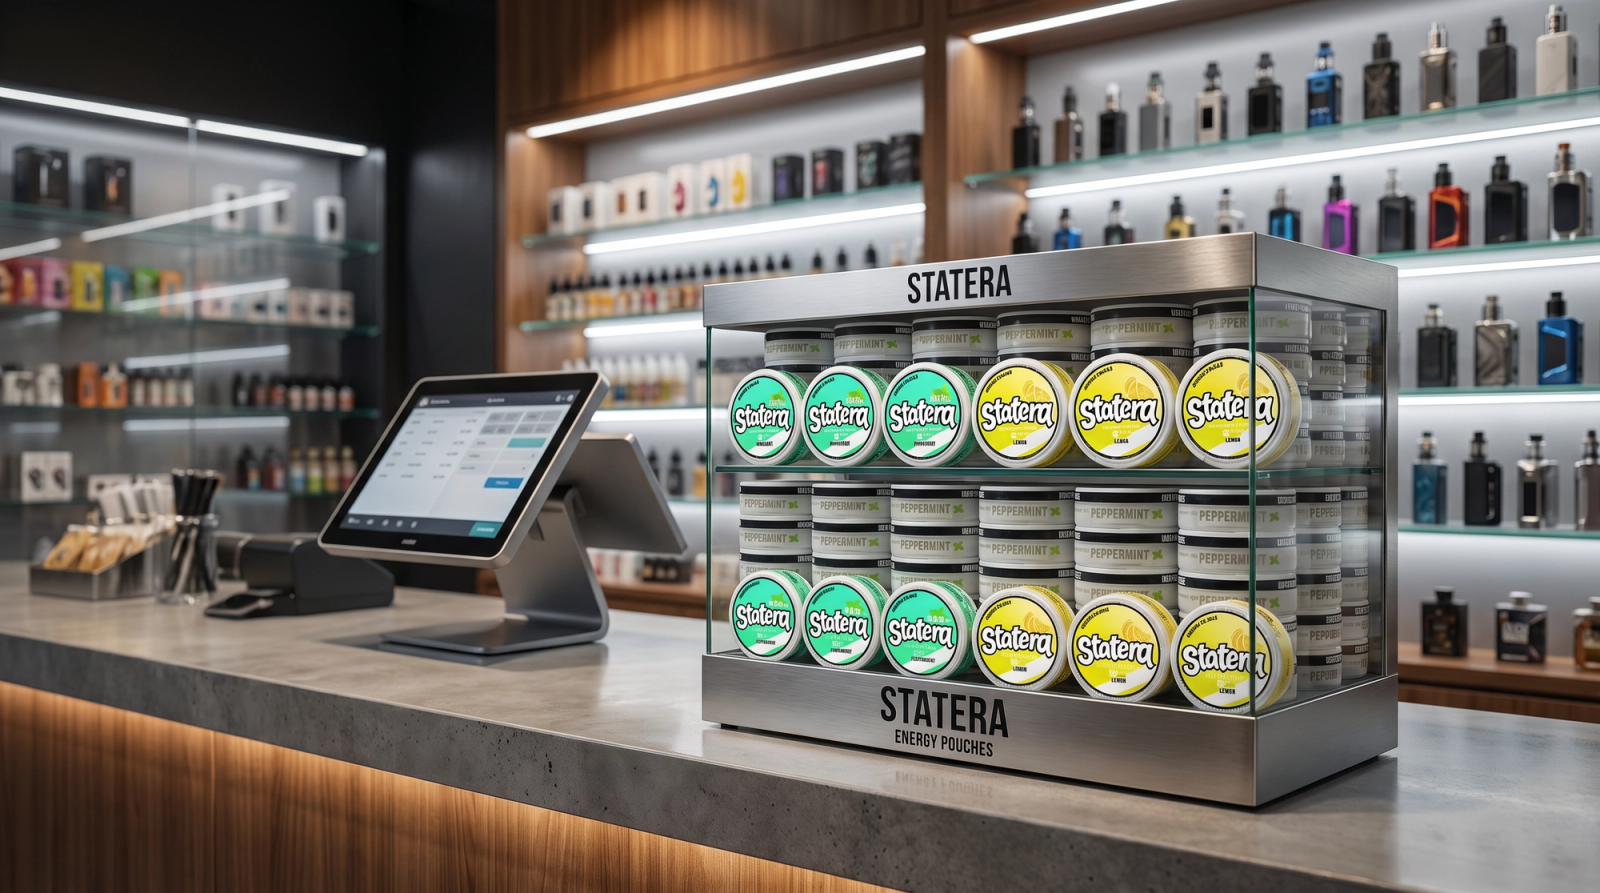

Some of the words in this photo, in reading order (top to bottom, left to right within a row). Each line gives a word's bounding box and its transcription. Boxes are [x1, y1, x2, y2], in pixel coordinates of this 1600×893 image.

[907, 264, 1012, 304] STATERA
[734, 402, 792, 435] Statera
[808, 400, 871, 434] Statera
[889, 398, 958, 433] Statera
[980, 396, 1055, 432] Statera
[1079, 393, 1160, 431] Statera
[744, 499, 787, 510] PEPPERMINT
[820, 500, 867, 511] PEPPERMINT
[900, 502, 951, 514] PEPPERMINT
[991, 505, 1048, 517] PEPPERMINT
[1090, 507, 1150, 520] PEPPERMINT
[744, 532, 787, 543] PEPPERMINT
[820, 536, 867, 547] PEPPERMINT
[900, 539, 951, 551] PEPPERMINT
[991, 543, 1048, 556] PEPPERMINT
[1090, 547, 1150, 560] PEPPERMINT
[735, 602, 792, 633] Statera
[809, 608, 870, 641] Statera
[888, 616, 955, 649] Statera
[980, 624, 1055, 658] Statera
[1076, 633, 1157, 670] Statera
[1181, 643, 1268, 679] Statera
[880, 685, 1009, 738] STATERA
[895, 728, 938, 749] ENERGY
[941, 735, 994, 757] POUCHES
